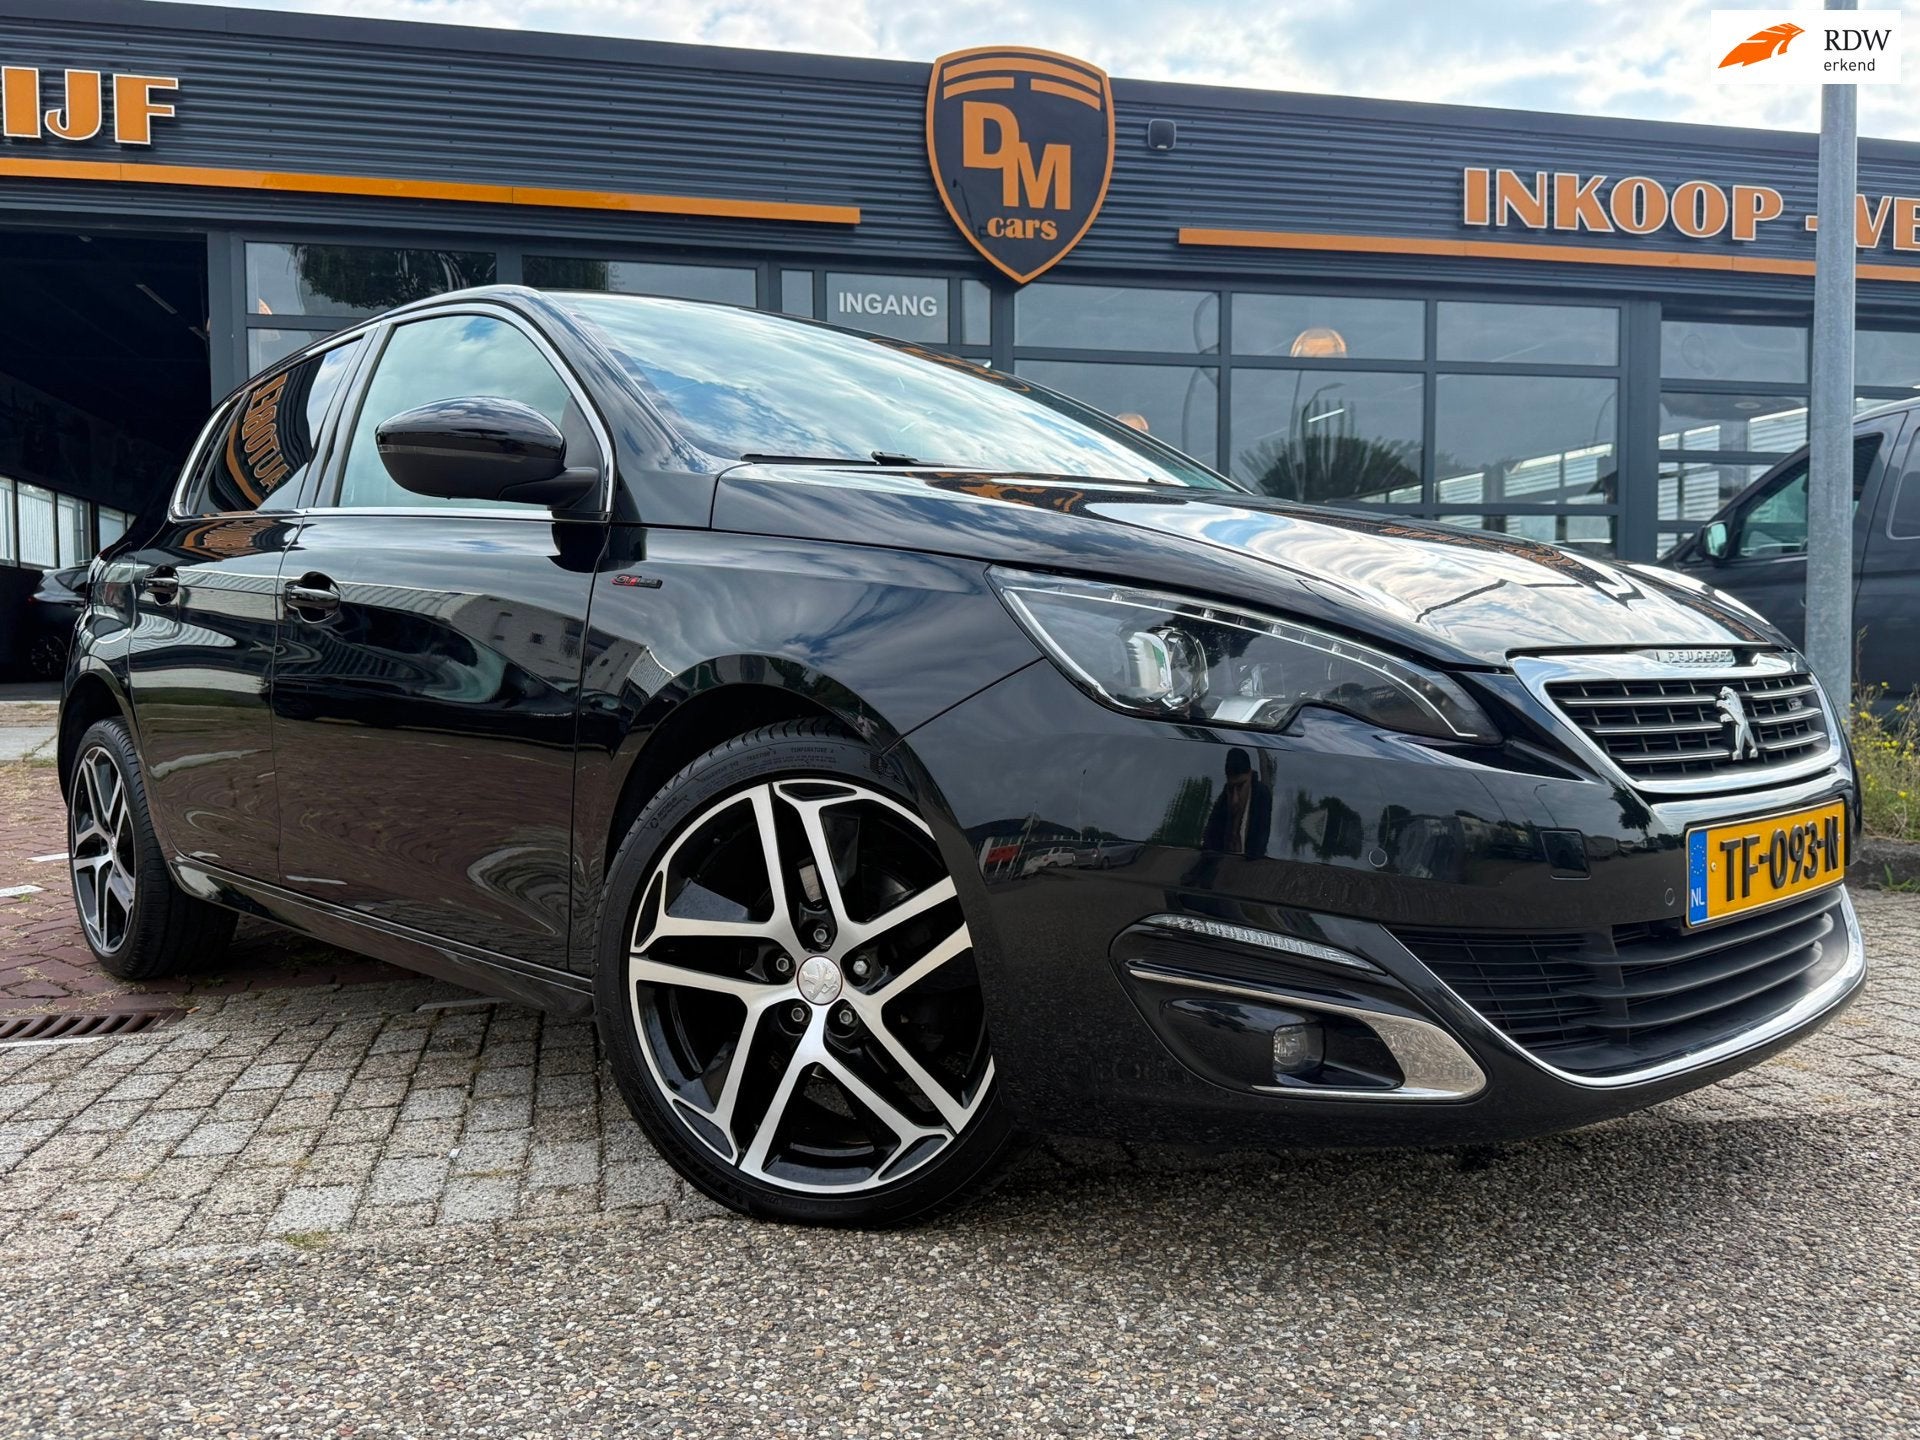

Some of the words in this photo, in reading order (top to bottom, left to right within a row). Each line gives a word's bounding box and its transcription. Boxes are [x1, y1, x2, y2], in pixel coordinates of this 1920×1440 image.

[2, 66, 179, 145] IJF
[963, 101, 1071, 210] DM
[987, 217, 1058, 240] cars
[1464, 167, 1784, 241] INKOOP
[839, 292, 938, 317] INGANG
[1719, 815, 1839, 902] TF-093-N
[1690, 887, 1705, 908] NL
